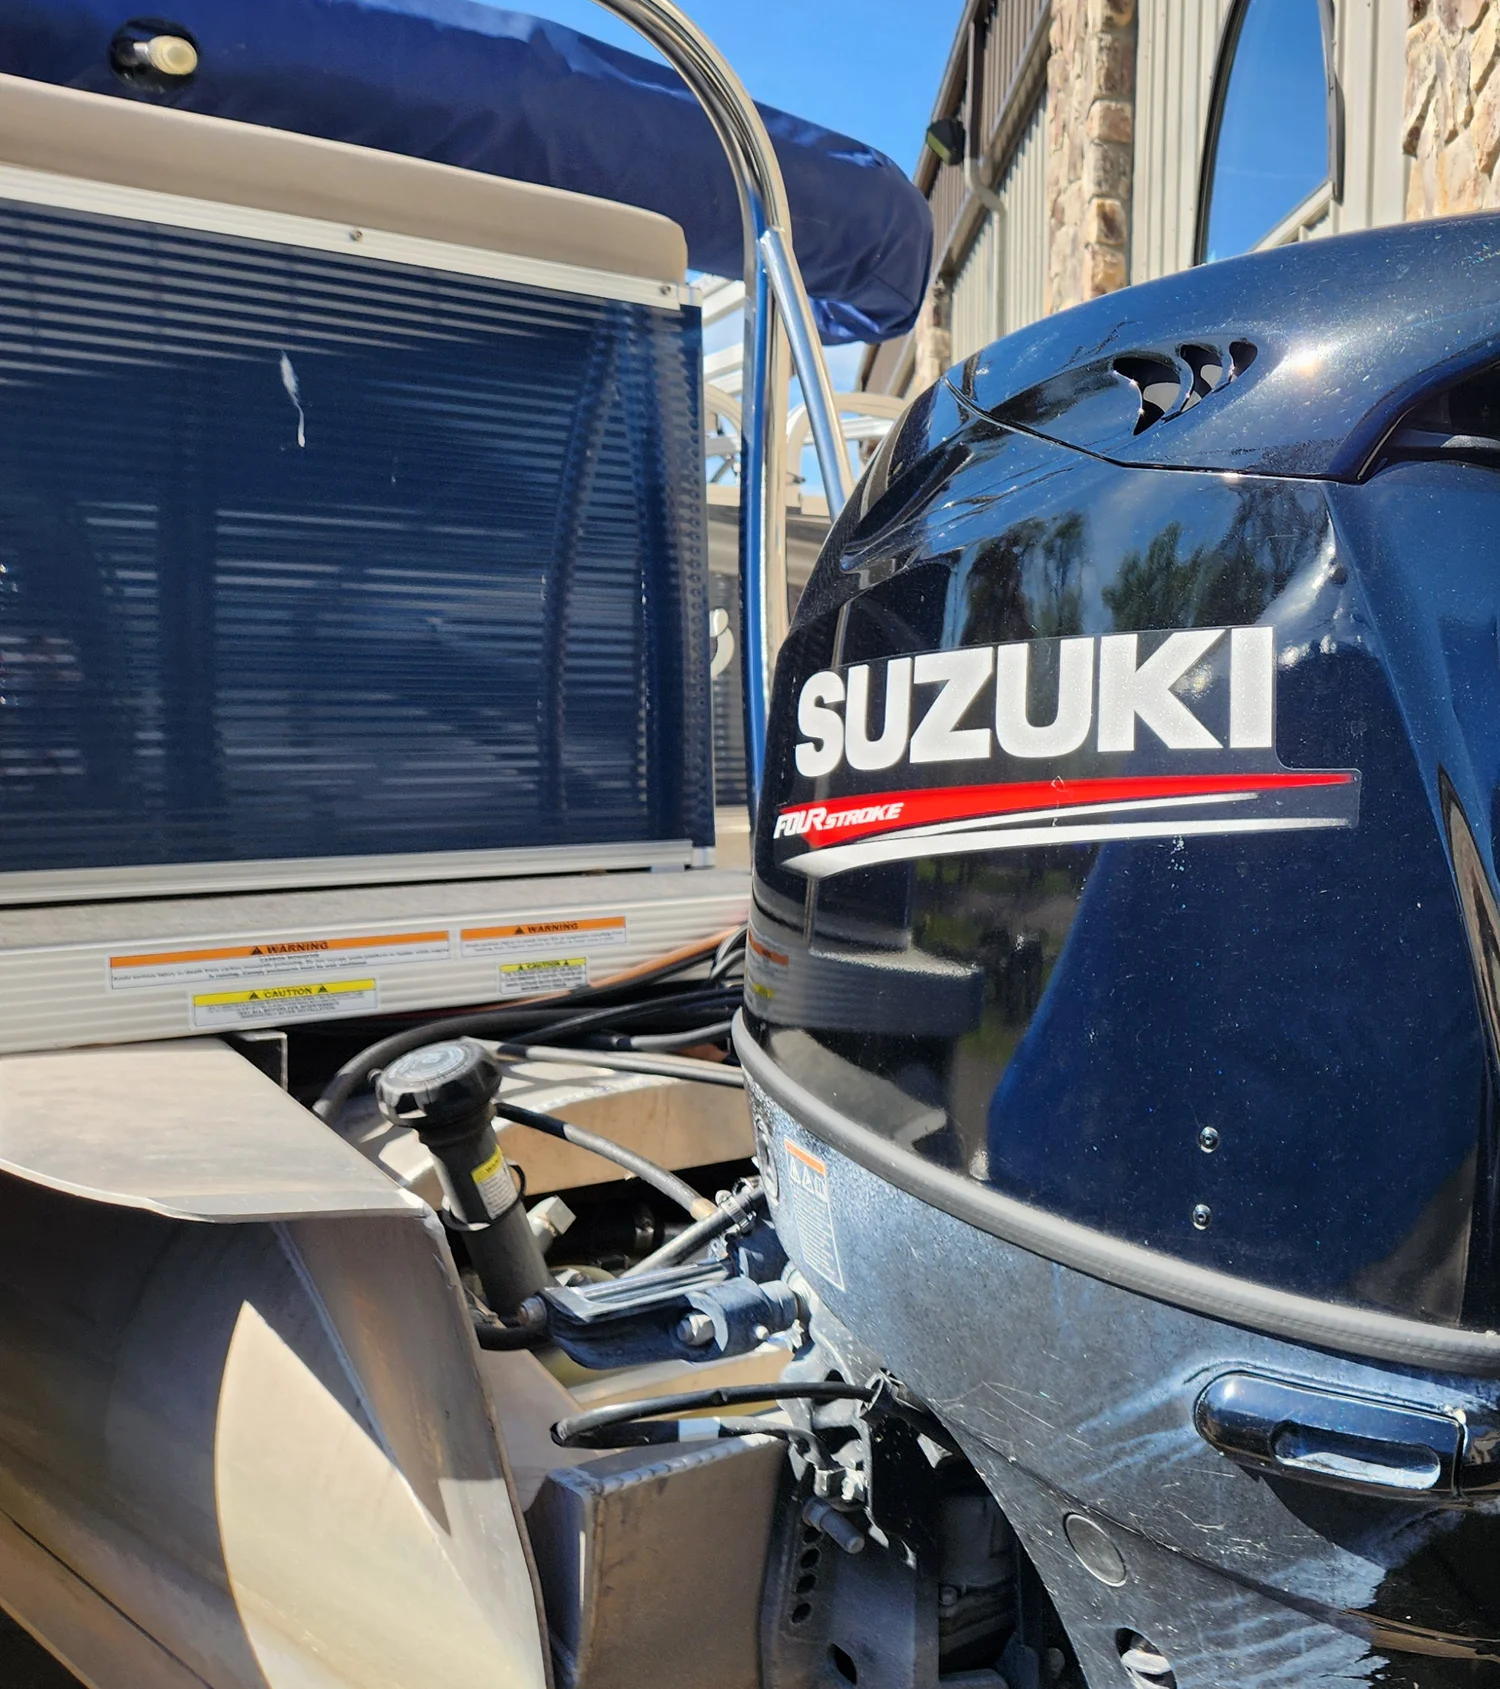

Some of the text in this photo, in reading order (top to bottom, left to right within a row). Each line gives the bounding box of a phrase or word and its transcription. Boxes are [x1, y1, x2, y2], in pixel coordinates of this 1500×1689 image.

[795, 626, 1274, 777] SUZUKI
[526, 922, 579, 934] WARNING
[266, 941, 329, 954] WARNING
[264, 987, 313, 999] CAUTION
